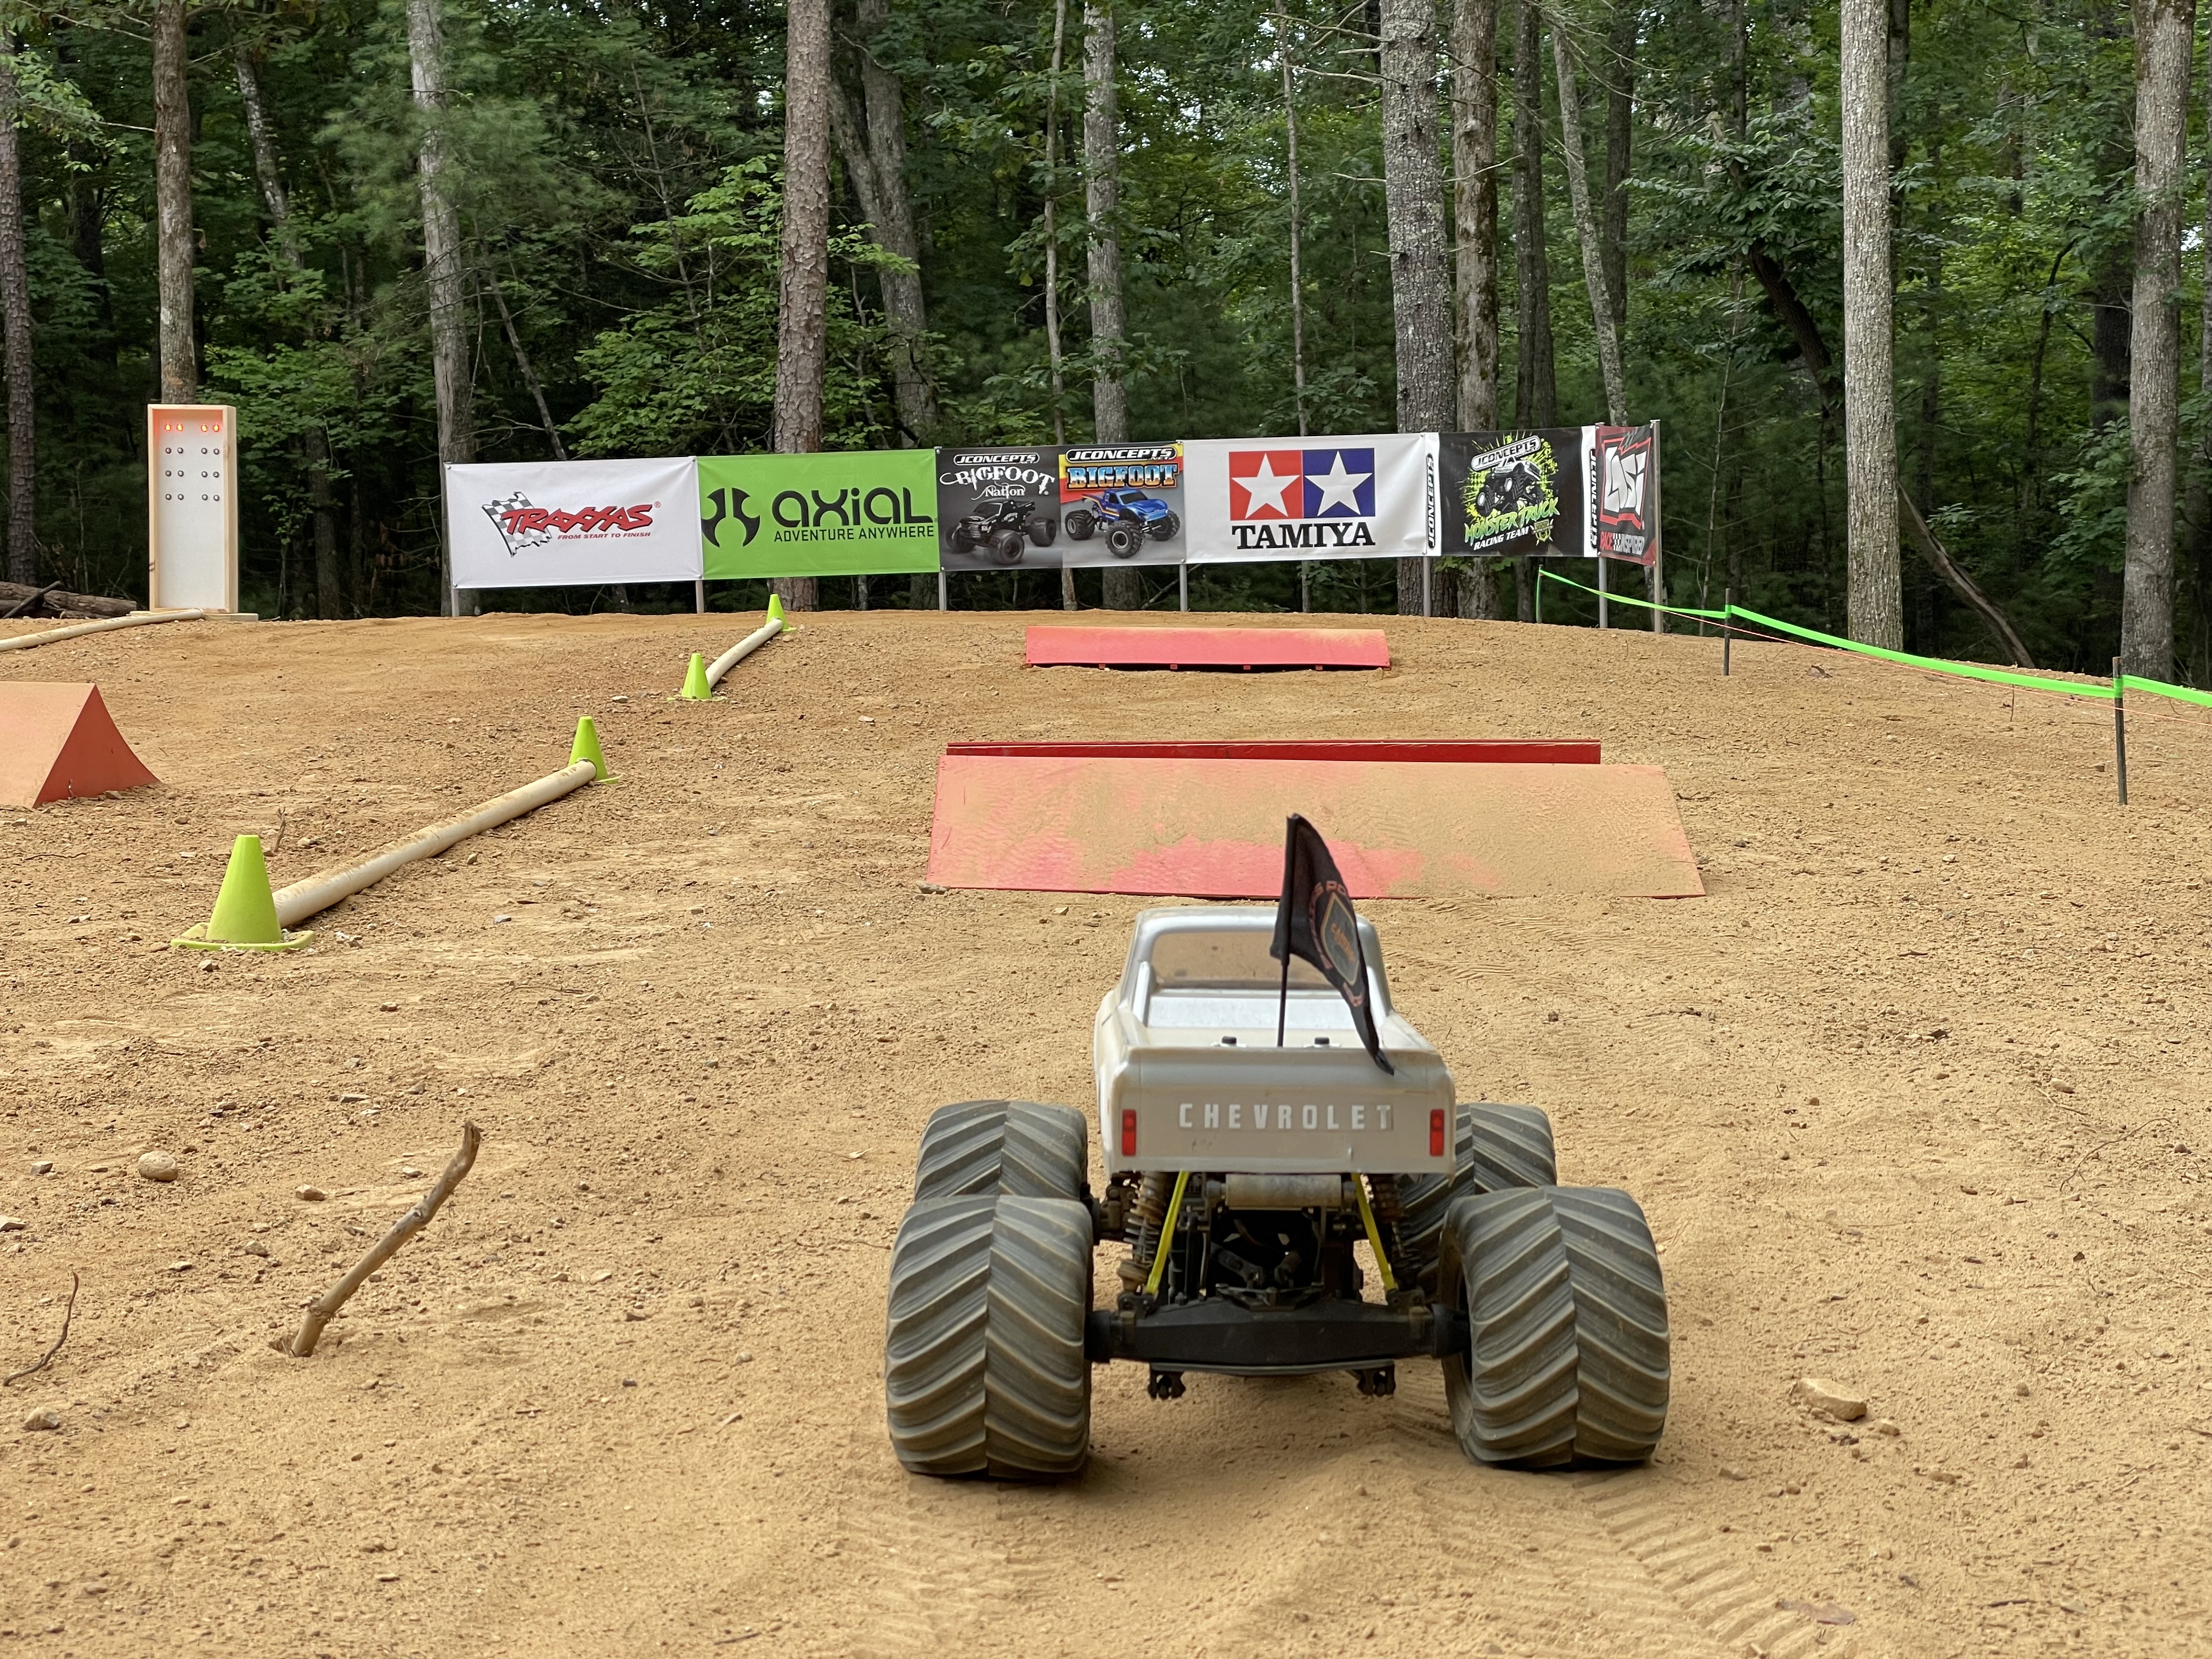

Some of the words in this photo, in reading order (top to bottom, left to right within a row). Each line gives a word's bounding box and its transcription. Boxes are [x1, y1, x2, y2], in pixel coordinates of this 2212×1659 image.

[957, 454, 1036, 463] JCONCEPTS
[1069, 448, 1172, 460] JCONCEPTS
[1475, 439, 1536, 467] JCONCEPTS
[940, 466, 1054, 495] BIGFOOT
[1066, 464, 1177, 488] BIGFOOT
[975, 482, 1025, 499] Nation
[1426, 456, 1435, 547] JCONCEPTS
[500, 504, 653, 535] TRAXXAS
[1464, 512, 1519, 546] MONSTER
[1518, 497, 1560, 528] TRUCK
[774, 528, 854, 542] ADVENTURE
[859, 526, 934, 539] ANYWHERE
[1232, 522, 1376, 550] TAMIYA
[1473, 534, 1505, 550] RACING
[1506, 526, 1530, 540] TEAM
[1179, 1103, 1392, 1131] CHEVROLET
